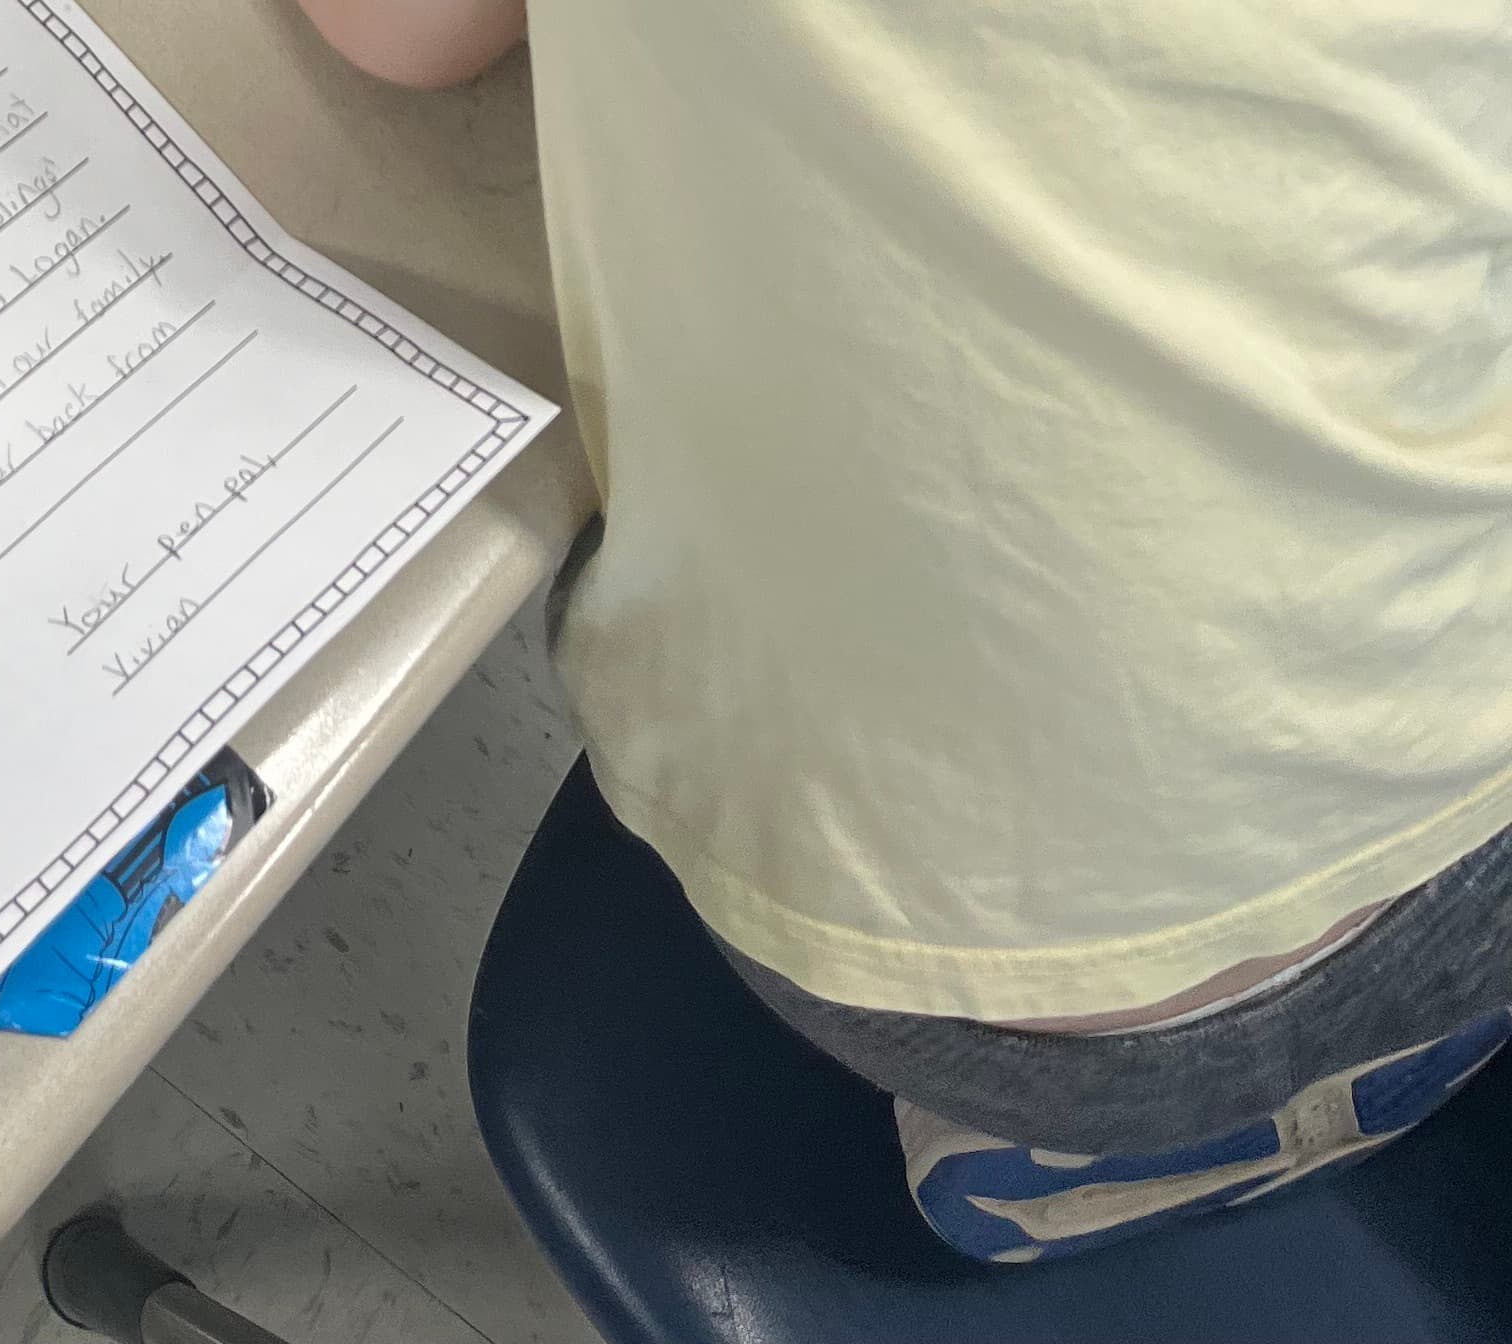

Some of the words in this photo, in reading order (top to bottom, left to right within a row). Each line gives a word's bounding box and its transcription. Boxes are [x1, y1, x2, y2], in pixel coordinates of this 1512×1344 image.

[8, 327, 56, 378] our
[23, 379, 100, 443] back
[104, 316, 180, 380] from
[46, 558, 139, 641] Your
[153, 497, 220, 563] pen
[97, 592, 207, 684] Vivian
